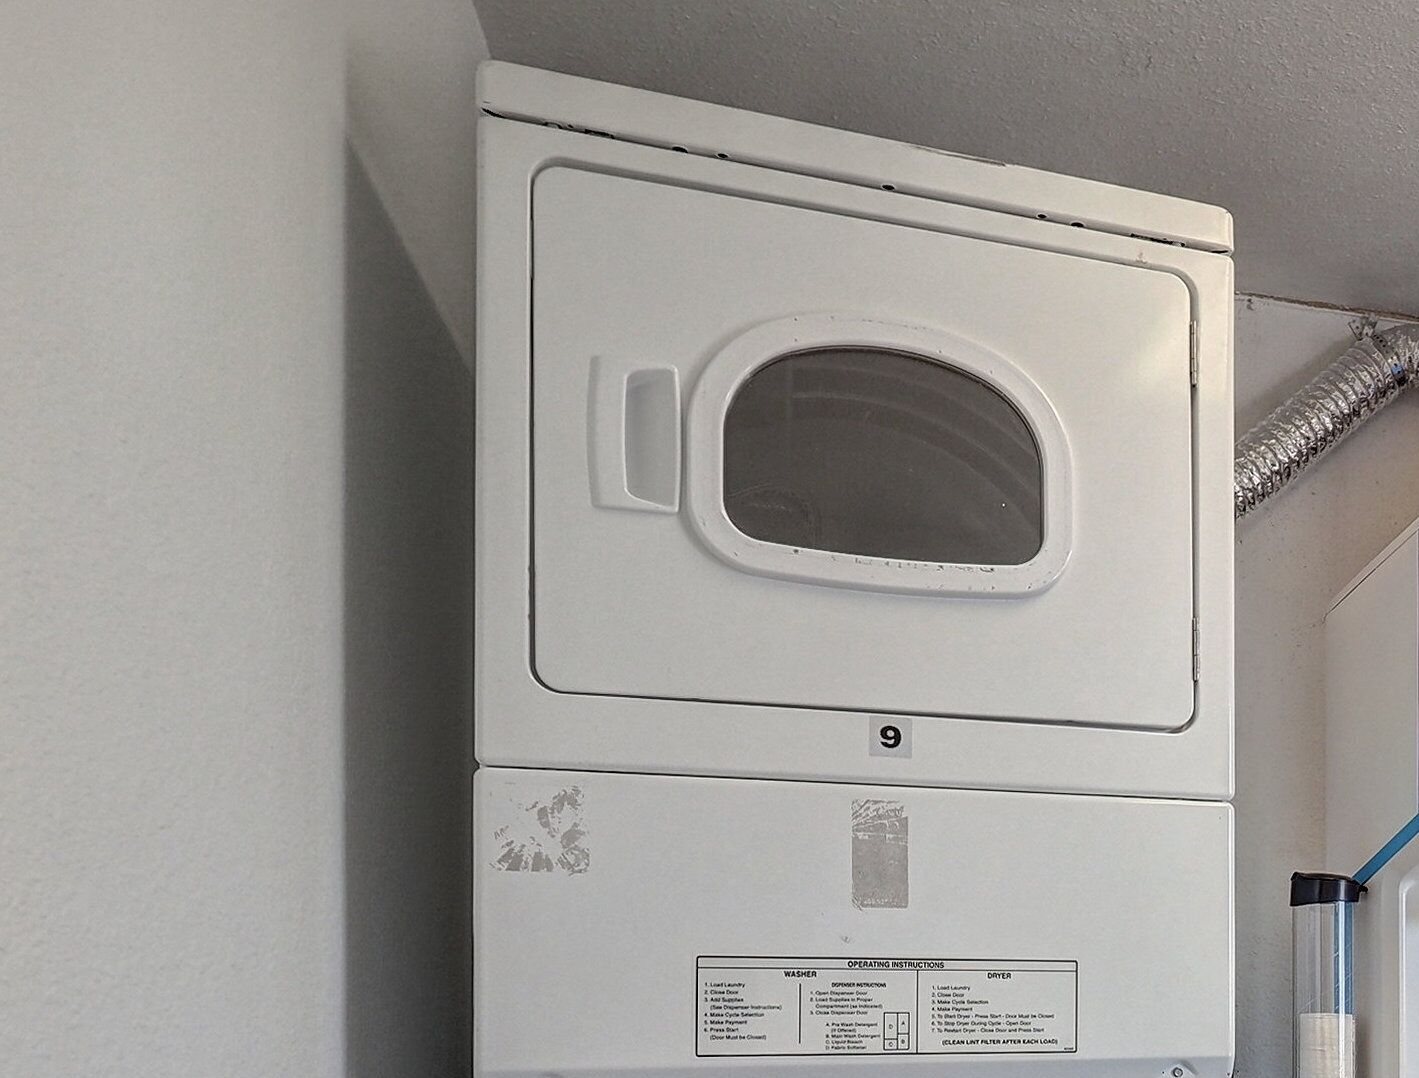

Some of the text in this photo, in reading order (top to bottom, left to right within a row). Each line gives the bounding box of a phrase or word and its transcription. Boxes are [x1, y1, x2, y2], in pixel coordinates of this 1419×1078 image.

[879, 725, 902, 749] 9
[847, 960, 945, 969] OPERATING INSTRUCTIONS
[784, 970, 817, 978] WASHER
